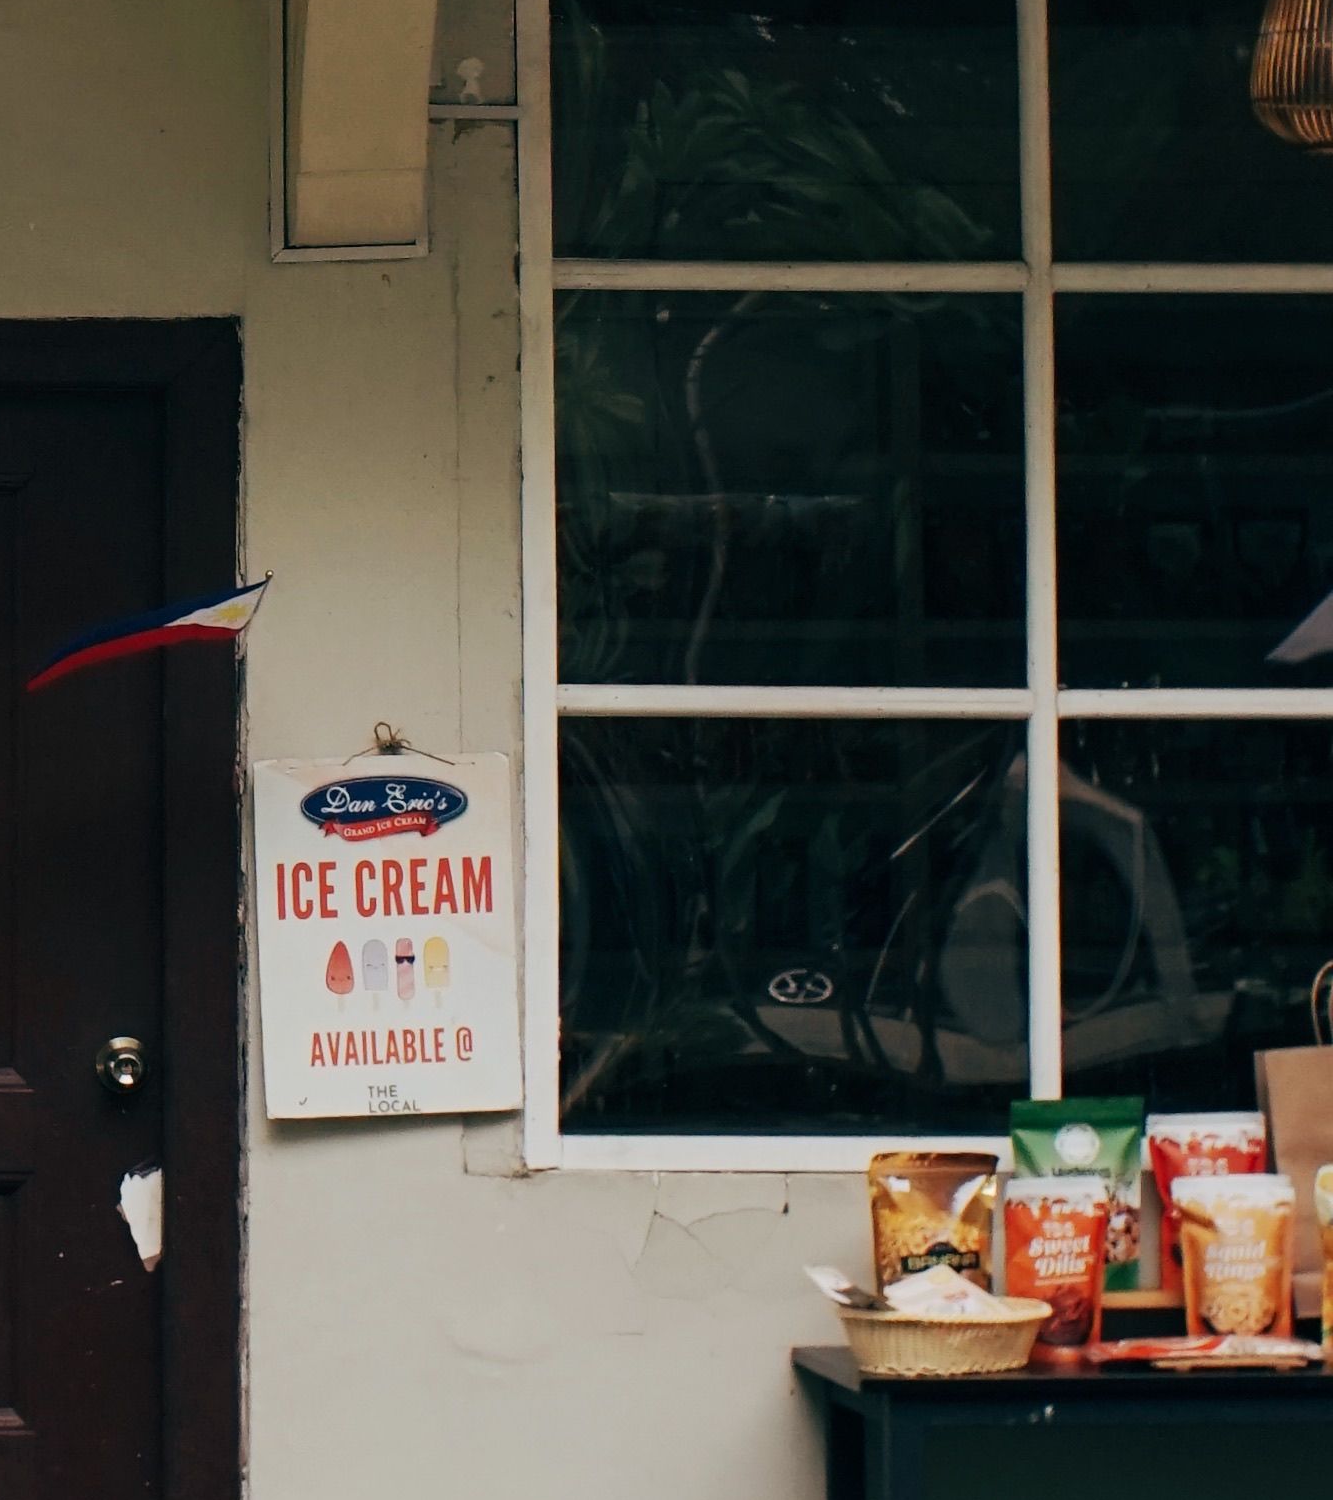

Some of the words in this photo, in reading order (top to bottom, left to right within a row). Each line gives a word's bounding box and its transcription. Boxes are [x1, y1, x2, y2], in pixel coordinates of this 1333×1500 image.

[321, 786, 376, 813] Dan
[276, 861, 338, 920] ICE
[355, 856, 493, 917] CREAM
[310, 1028, 446, 1067] AVAILABLE
[456, 1026, 473, 1062] @
[368, 1085, 398, 1098] THE
[368, 1099, 421, 1114] LOCAL
